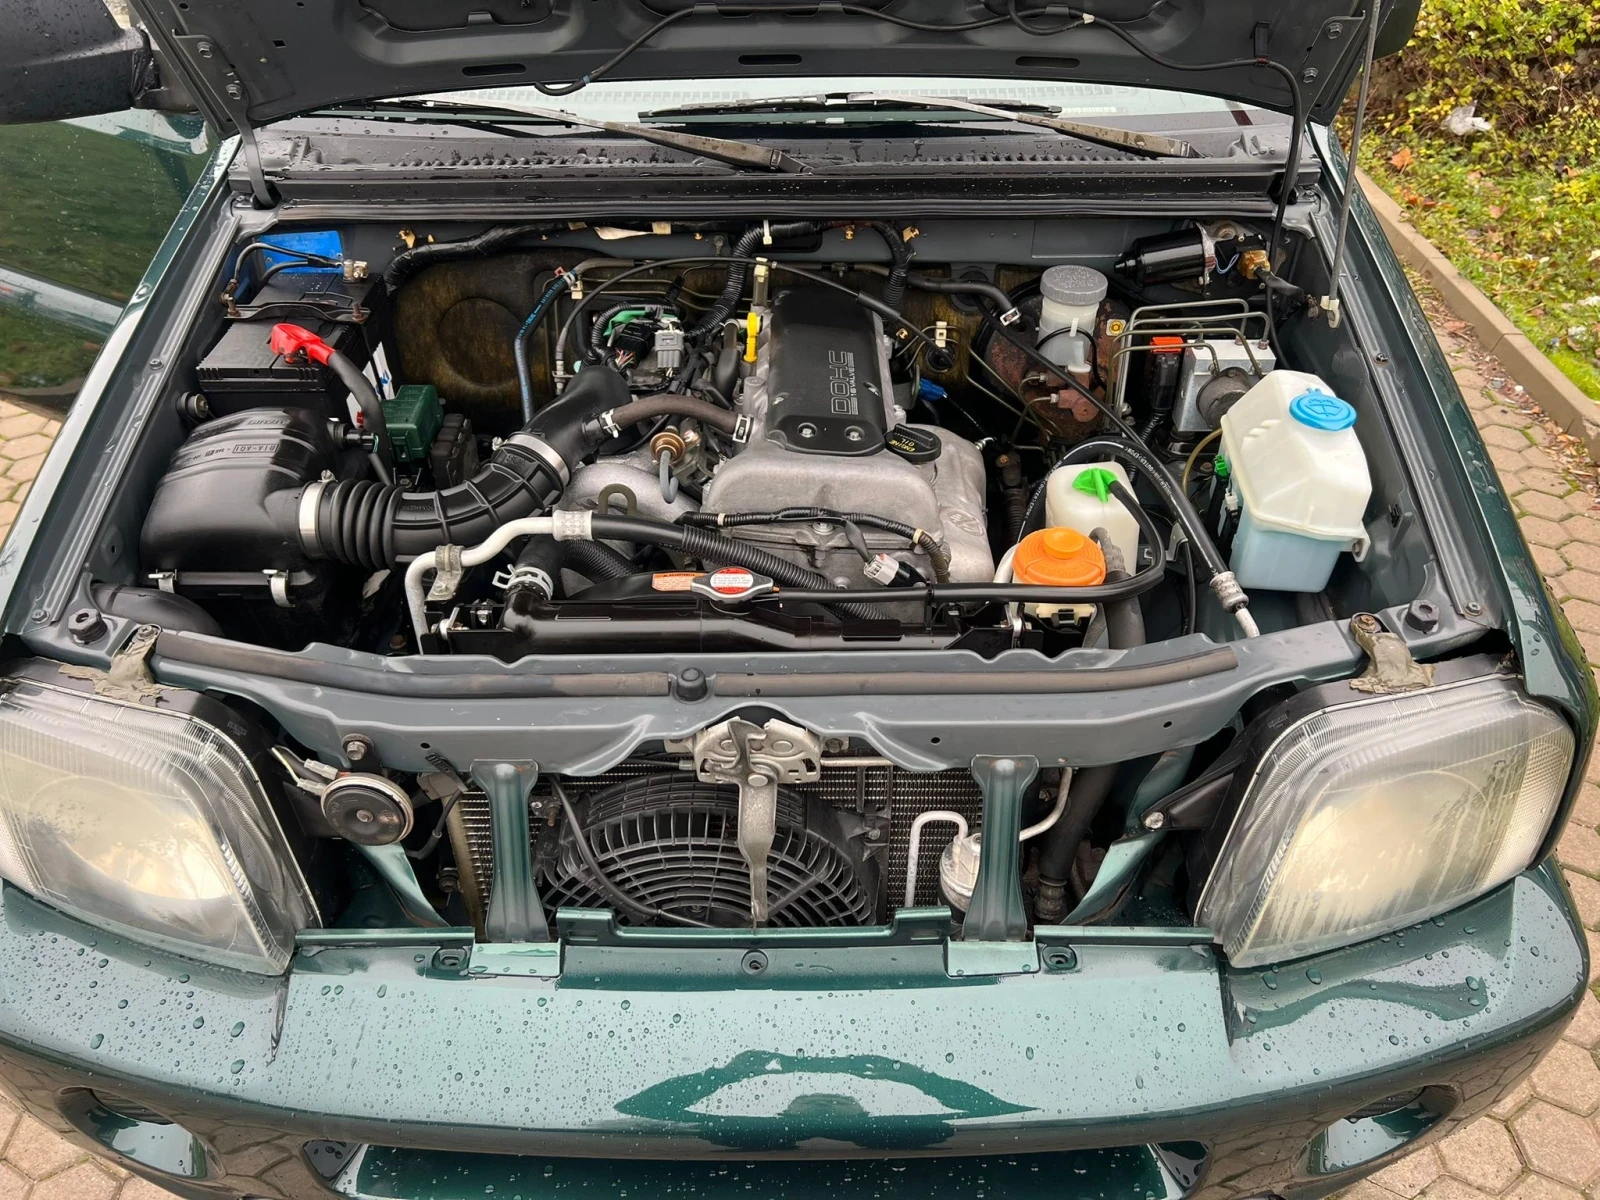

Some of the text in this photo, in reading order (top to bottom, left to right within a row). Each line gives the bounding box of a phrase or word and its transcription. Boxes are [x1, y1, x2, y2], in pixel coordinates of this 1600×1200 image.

[829, 350, 851, 414] DOHC
[889, 440, 915, 452] ENGINE
[902, 438, 915, 447] OIL
